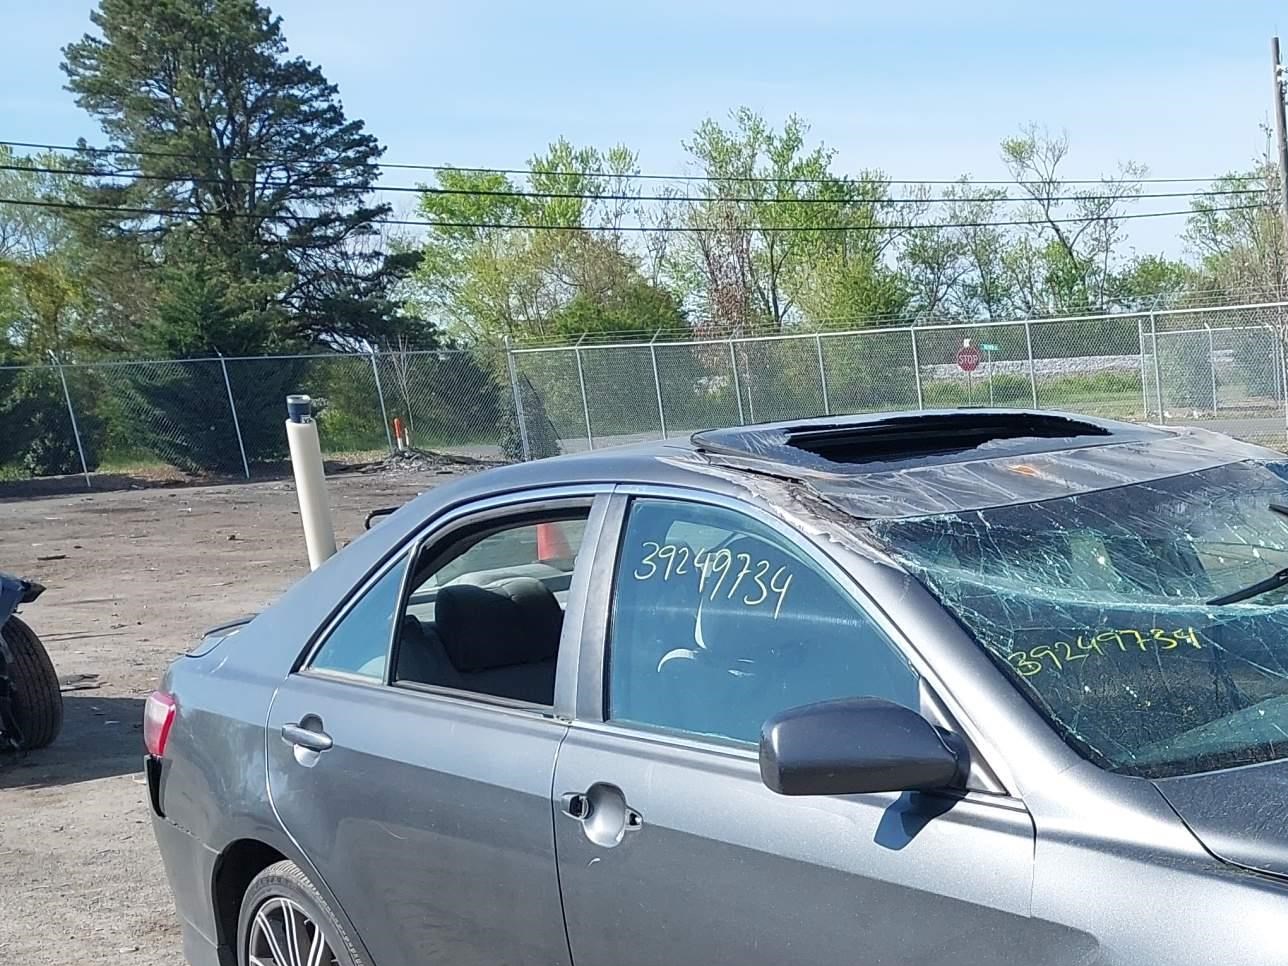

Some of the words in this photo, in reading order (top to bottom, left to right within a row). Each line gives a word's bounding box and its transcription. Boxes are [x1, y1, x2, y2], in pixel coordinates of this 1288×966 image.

[959, 354, 978, 364] STOP
[633, 541, 793, 619] 39249734
[1007, 625, 1202, 677] 39249734
